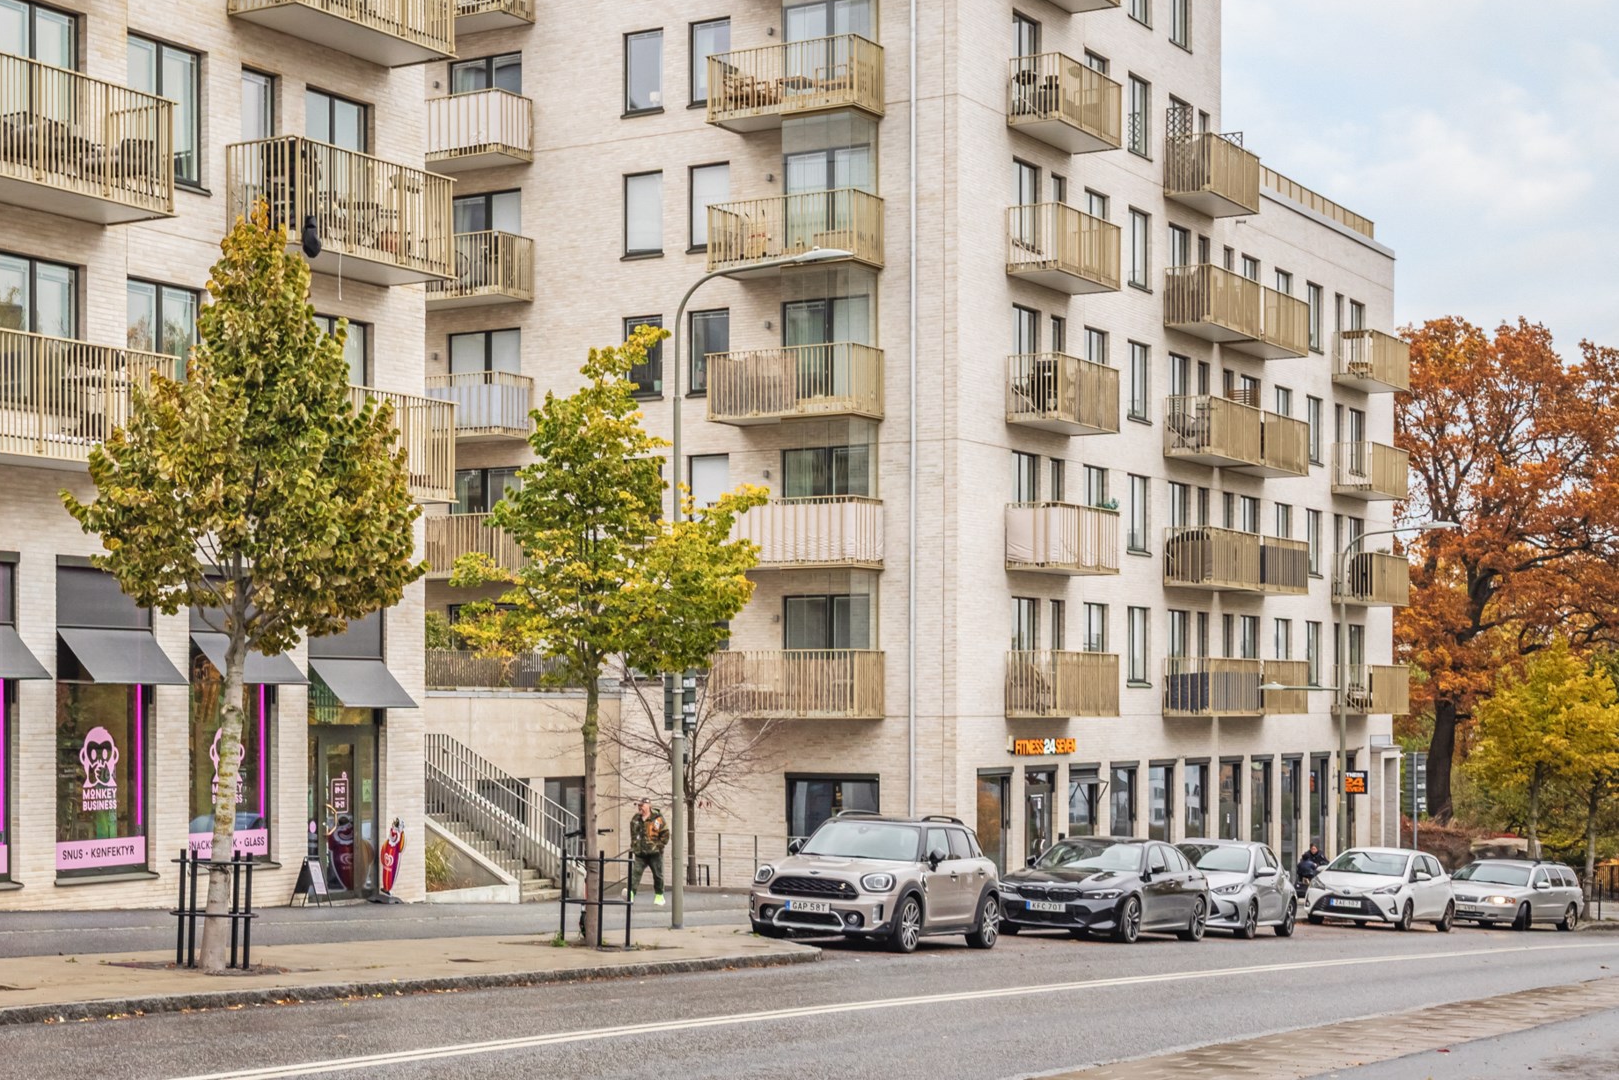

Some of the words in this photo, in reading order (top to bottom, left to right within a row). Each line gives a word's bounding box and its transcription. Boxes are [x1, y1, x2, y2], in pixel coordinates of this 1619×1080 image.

[83, 788, 117, 800] MONKEY
[83, 800, 117, 811] BUSINESS
[244, 837, 265, 848] GLASS
[62, 849, 83, 861] SNUS
[91, 845, 135, 859] KONFEKTYR
[792, 903, 808, 911] GAP
[810, 903, 826, 912] 58T
[1032, 902, 1046, 910] KFC
